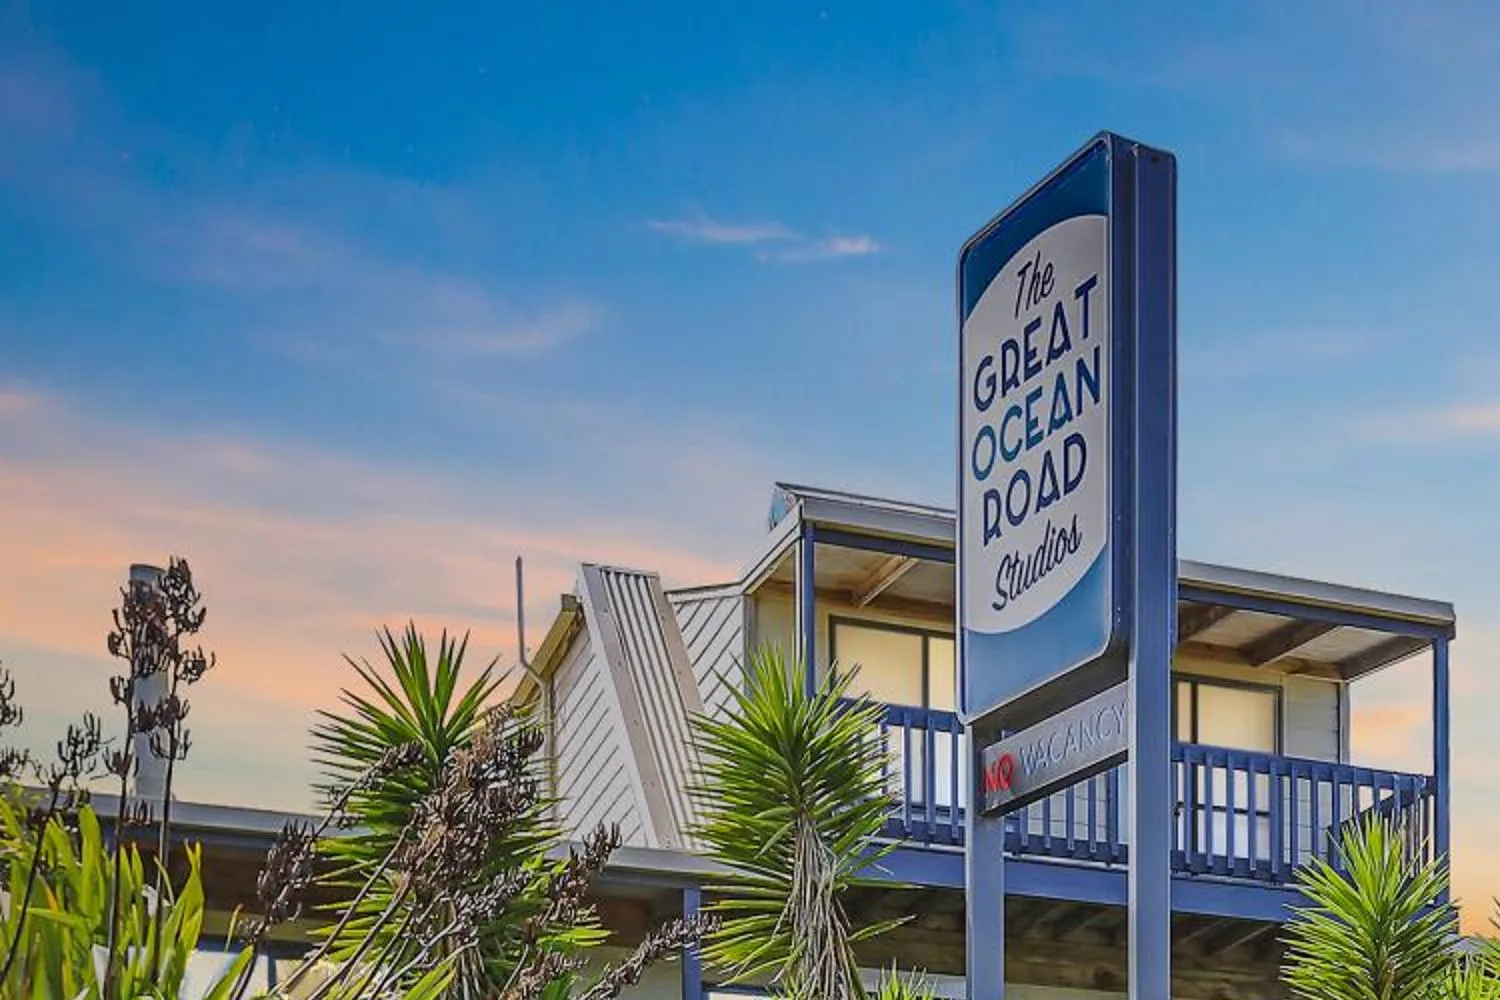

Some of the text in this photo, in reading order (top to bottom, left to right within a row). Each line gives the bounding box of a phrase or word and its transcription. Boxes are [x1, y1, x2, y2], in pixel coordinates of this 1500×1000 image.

[1013, 251, 1056, 319] The
[973, 273, 1098, 412] GREAT
[971, 344, 1101, 482] OCEAN
[982, 431, 1087, 547] ROAD
[992, 513, 1083, 612] Studios
[983, 702, 1127, 795] NO VACANCY
